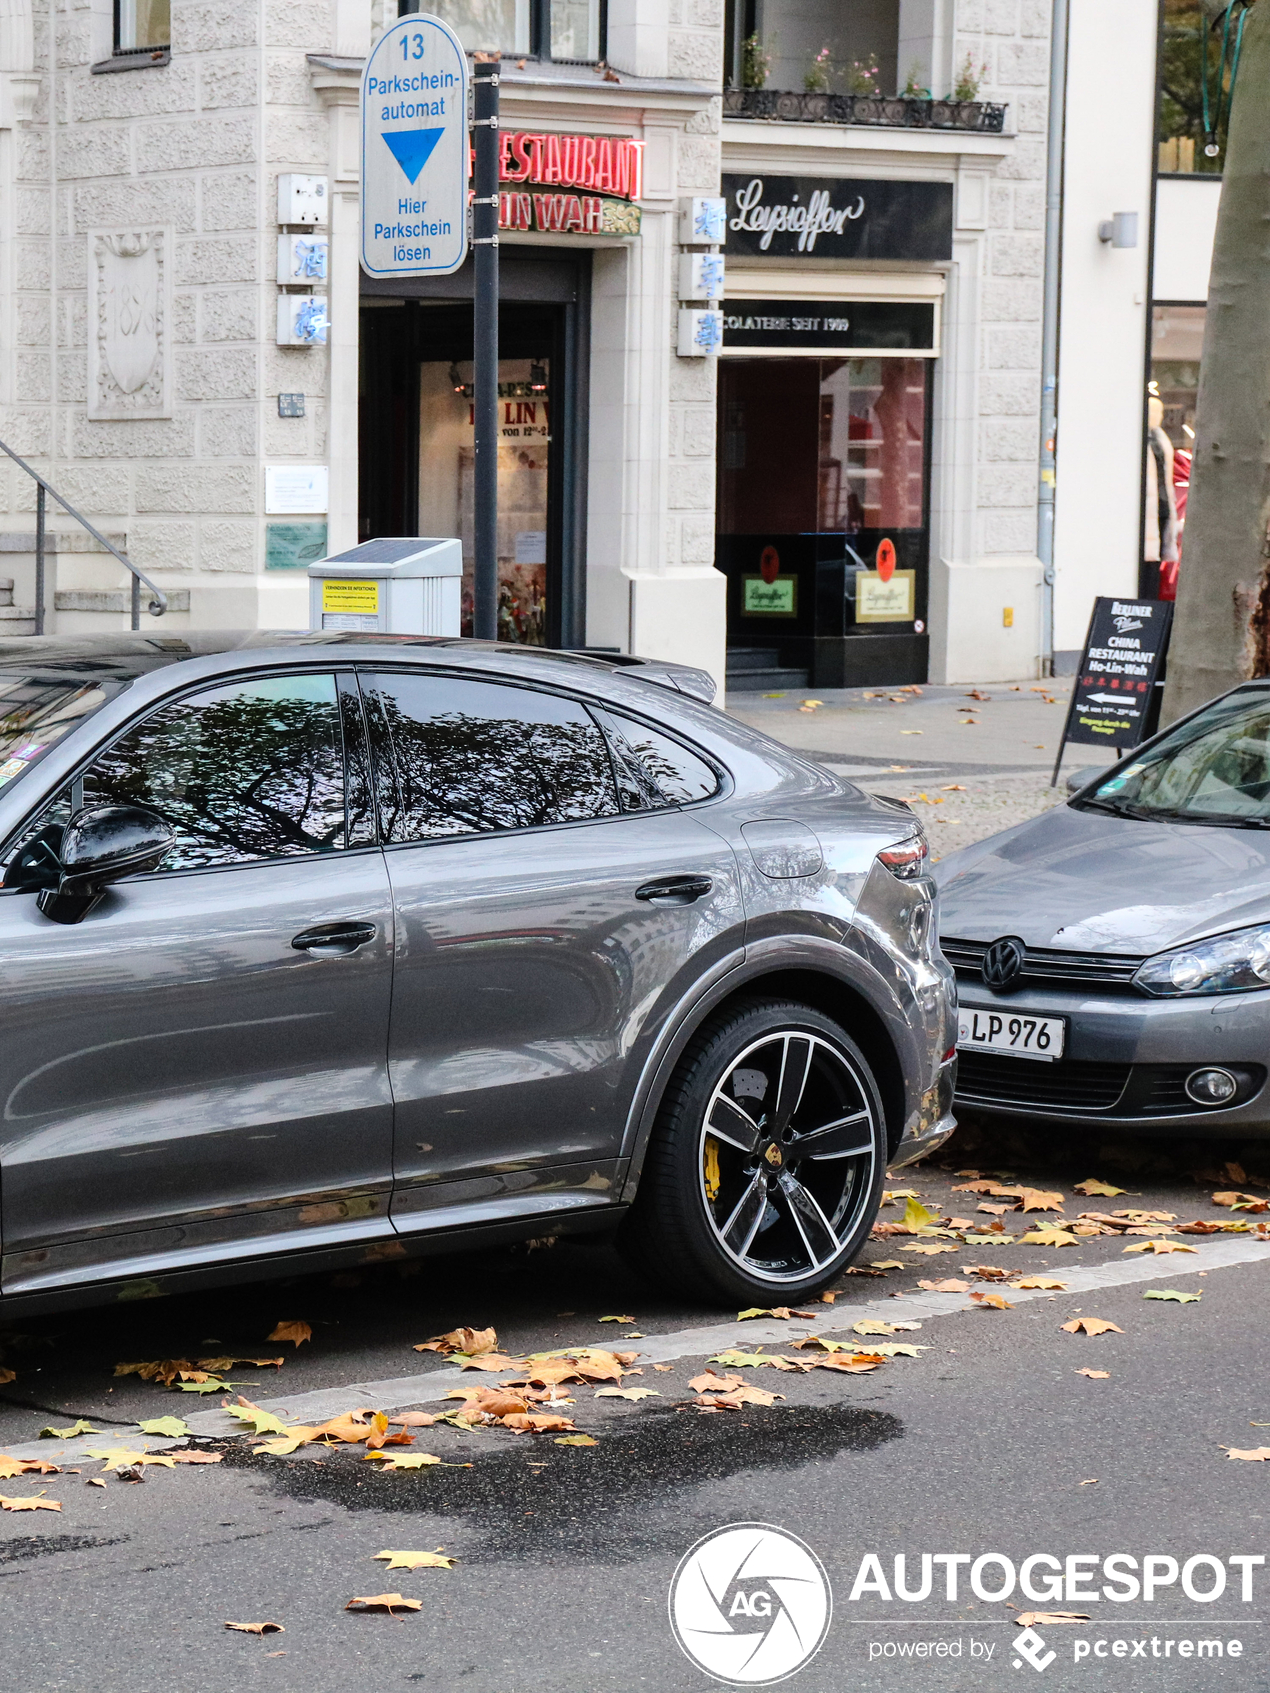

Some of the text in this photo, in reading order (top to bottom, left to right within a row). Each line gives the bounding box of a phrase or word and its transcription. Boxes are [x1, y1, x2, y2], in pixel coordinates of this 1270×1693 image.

[399, 33, 424, 60] 13
[368, 70, 460, 95] Parkschein-
[381, 97, 446, 121] automat
[398, 198, 427, 215] Hier
[533, 193, 603, 235] WAH
[730, 179, 865, 252] Leysieffer
[374, 219, 451, 239] Parkschein
[393, 245, 431, 262] lösen
[504, 402, 536, 425] LIN
[1107, 636, 1141, 650] CHINA
[1088, 648, 1156, 664] RESTAURANT
[1088, 660, 1148, 676] Ho-Lin-Wah
[972, 1013, 1051, 1050] LP 976
